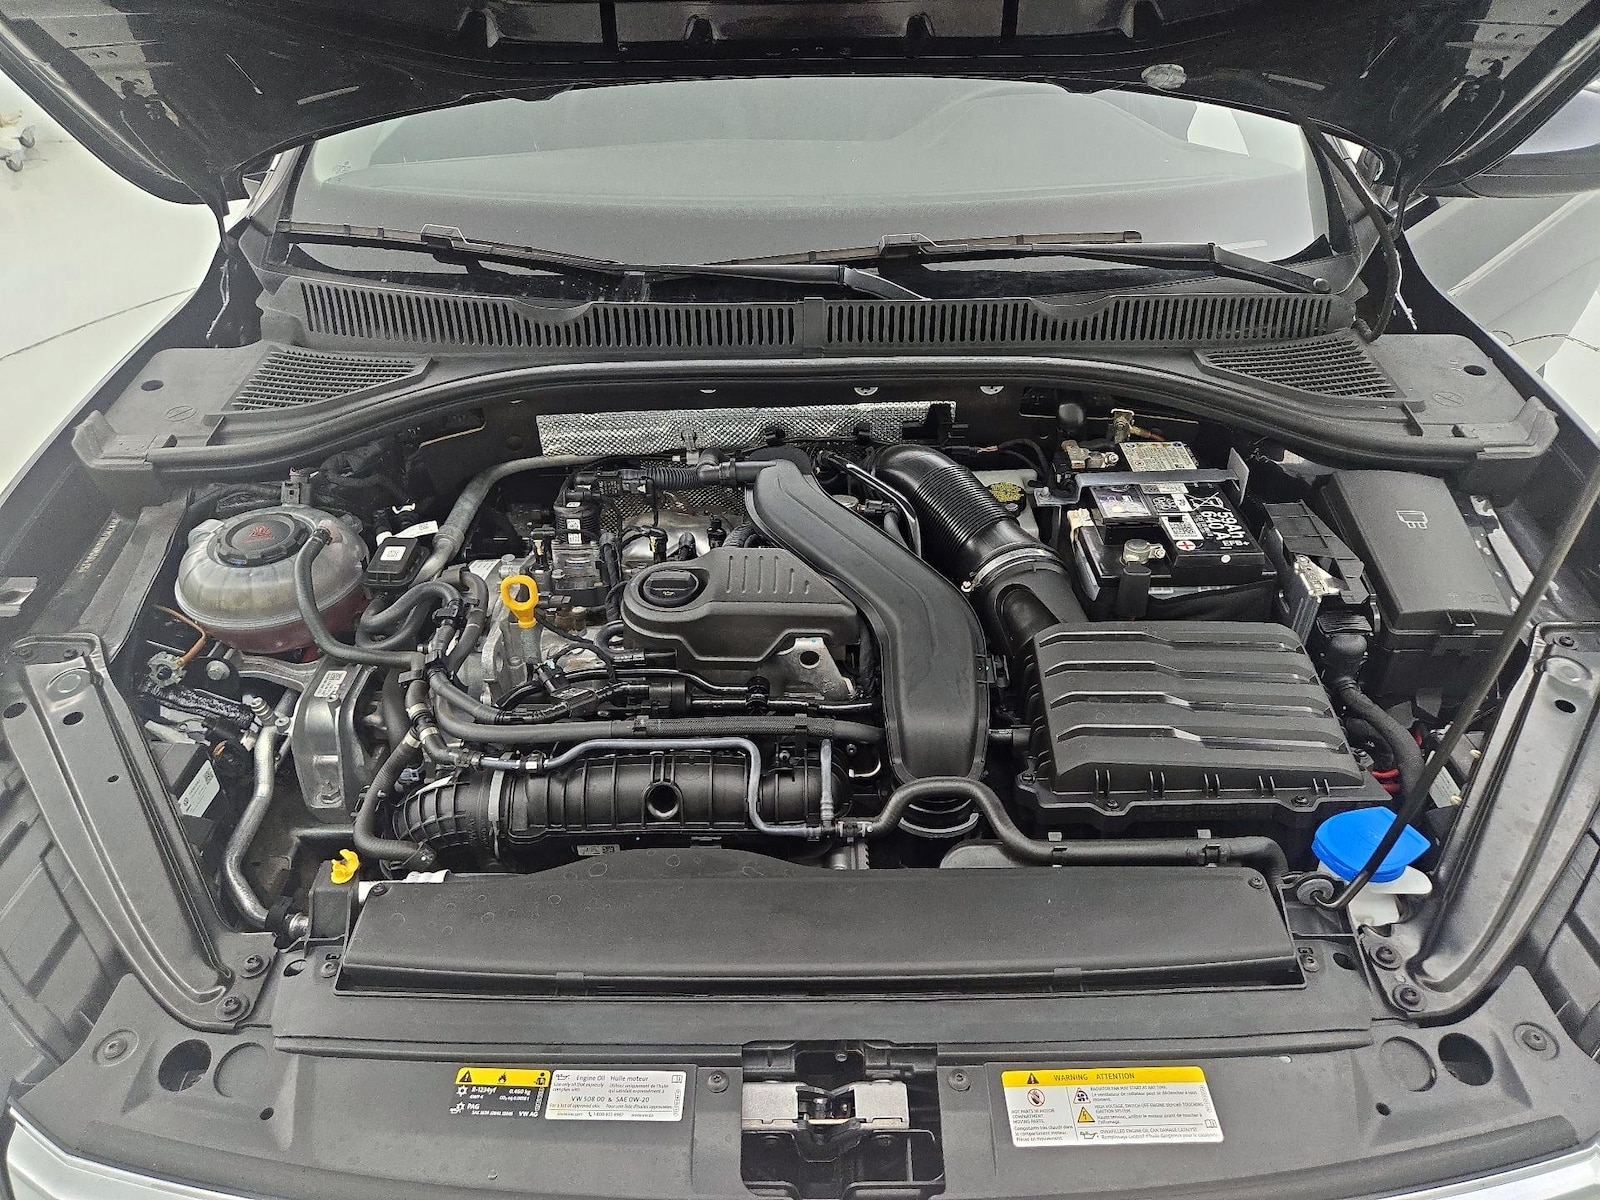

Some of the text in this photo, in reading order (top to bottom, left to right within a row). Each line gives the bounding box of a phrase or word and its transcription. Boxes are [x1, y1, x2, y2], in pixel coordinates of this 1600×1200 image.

[1201, 511, 1225, 529] 640
[1213, 531, 1231, 540] A
[1217, 512, 1246, 538] 59Ah
[471, 1086, 498, 1095] R-1234yf
